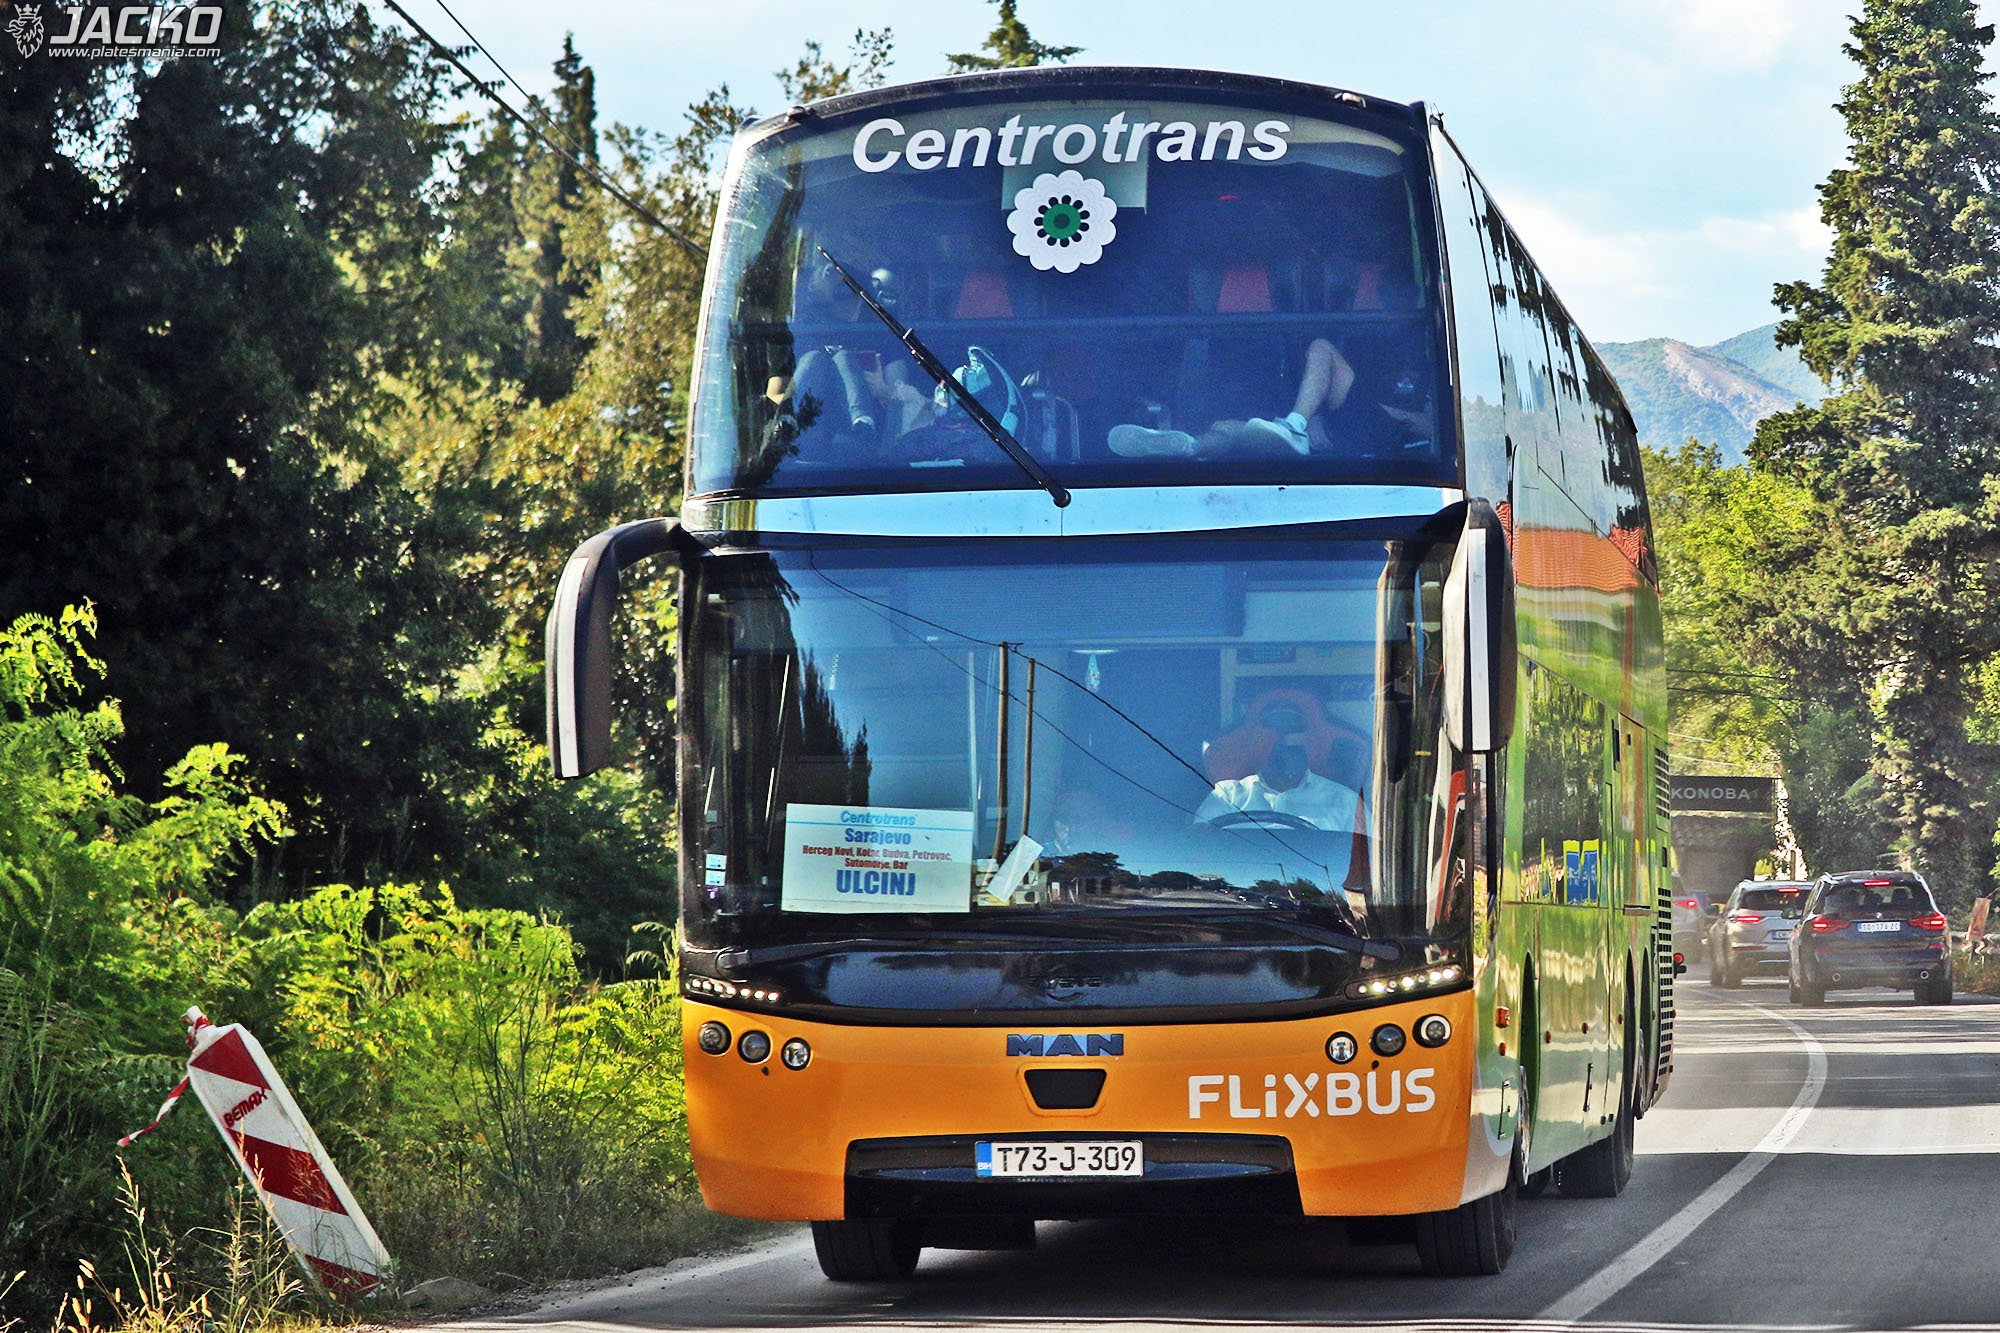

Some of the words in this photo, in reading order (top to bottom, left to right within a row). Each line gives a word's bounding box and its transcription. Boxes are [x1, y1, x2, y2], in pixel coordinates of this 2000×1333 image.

[852, 110, 1291, 174] Centrotrans
[1671, 787, 1750, 800] KONOBA
[840, 810, 917, 826] Centrotrans
[845, 828, 911, 845] Sarajevo
[803, 845, 833, 856] Herceg
[893, 860, 908, 870] Bar
[836, 869, 916, 896] ULCINJ
[1006, 1033, 1124, 1056] MAN
[977, 1161, 992, 1171] BIH
[997, 1146, 1136, 1172] T73-J-309
